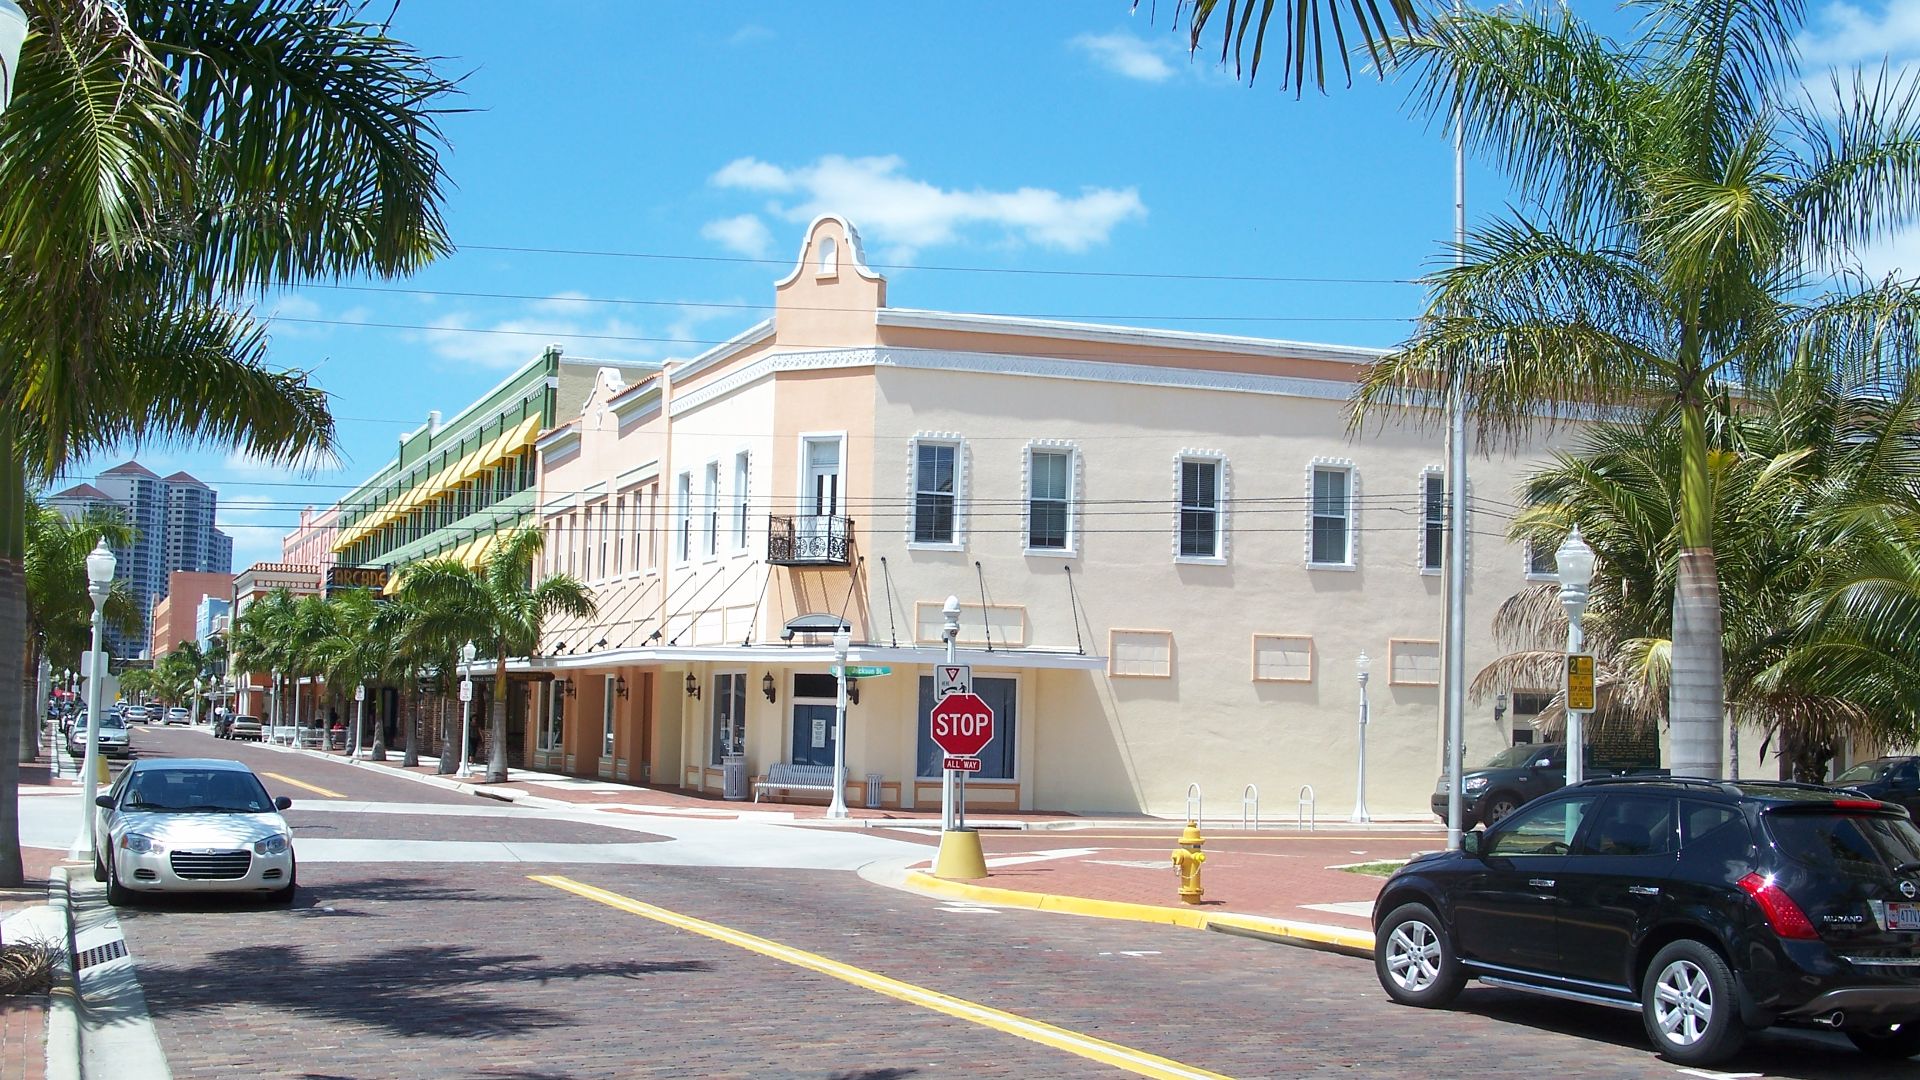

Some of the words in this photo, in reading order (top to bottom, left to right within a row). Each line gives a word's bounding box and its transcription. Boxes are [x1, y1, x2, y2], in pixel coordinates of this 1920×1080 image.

[334, 569, 386, 586] ARCADE
[850, 667, 875, 675] Jackson
[1570, 658, 1577, 673] 2
[936, 713, 989, 736] STOP
[946, 760, 960, 769] ALL
[963, 761, 978, 769] WAY
